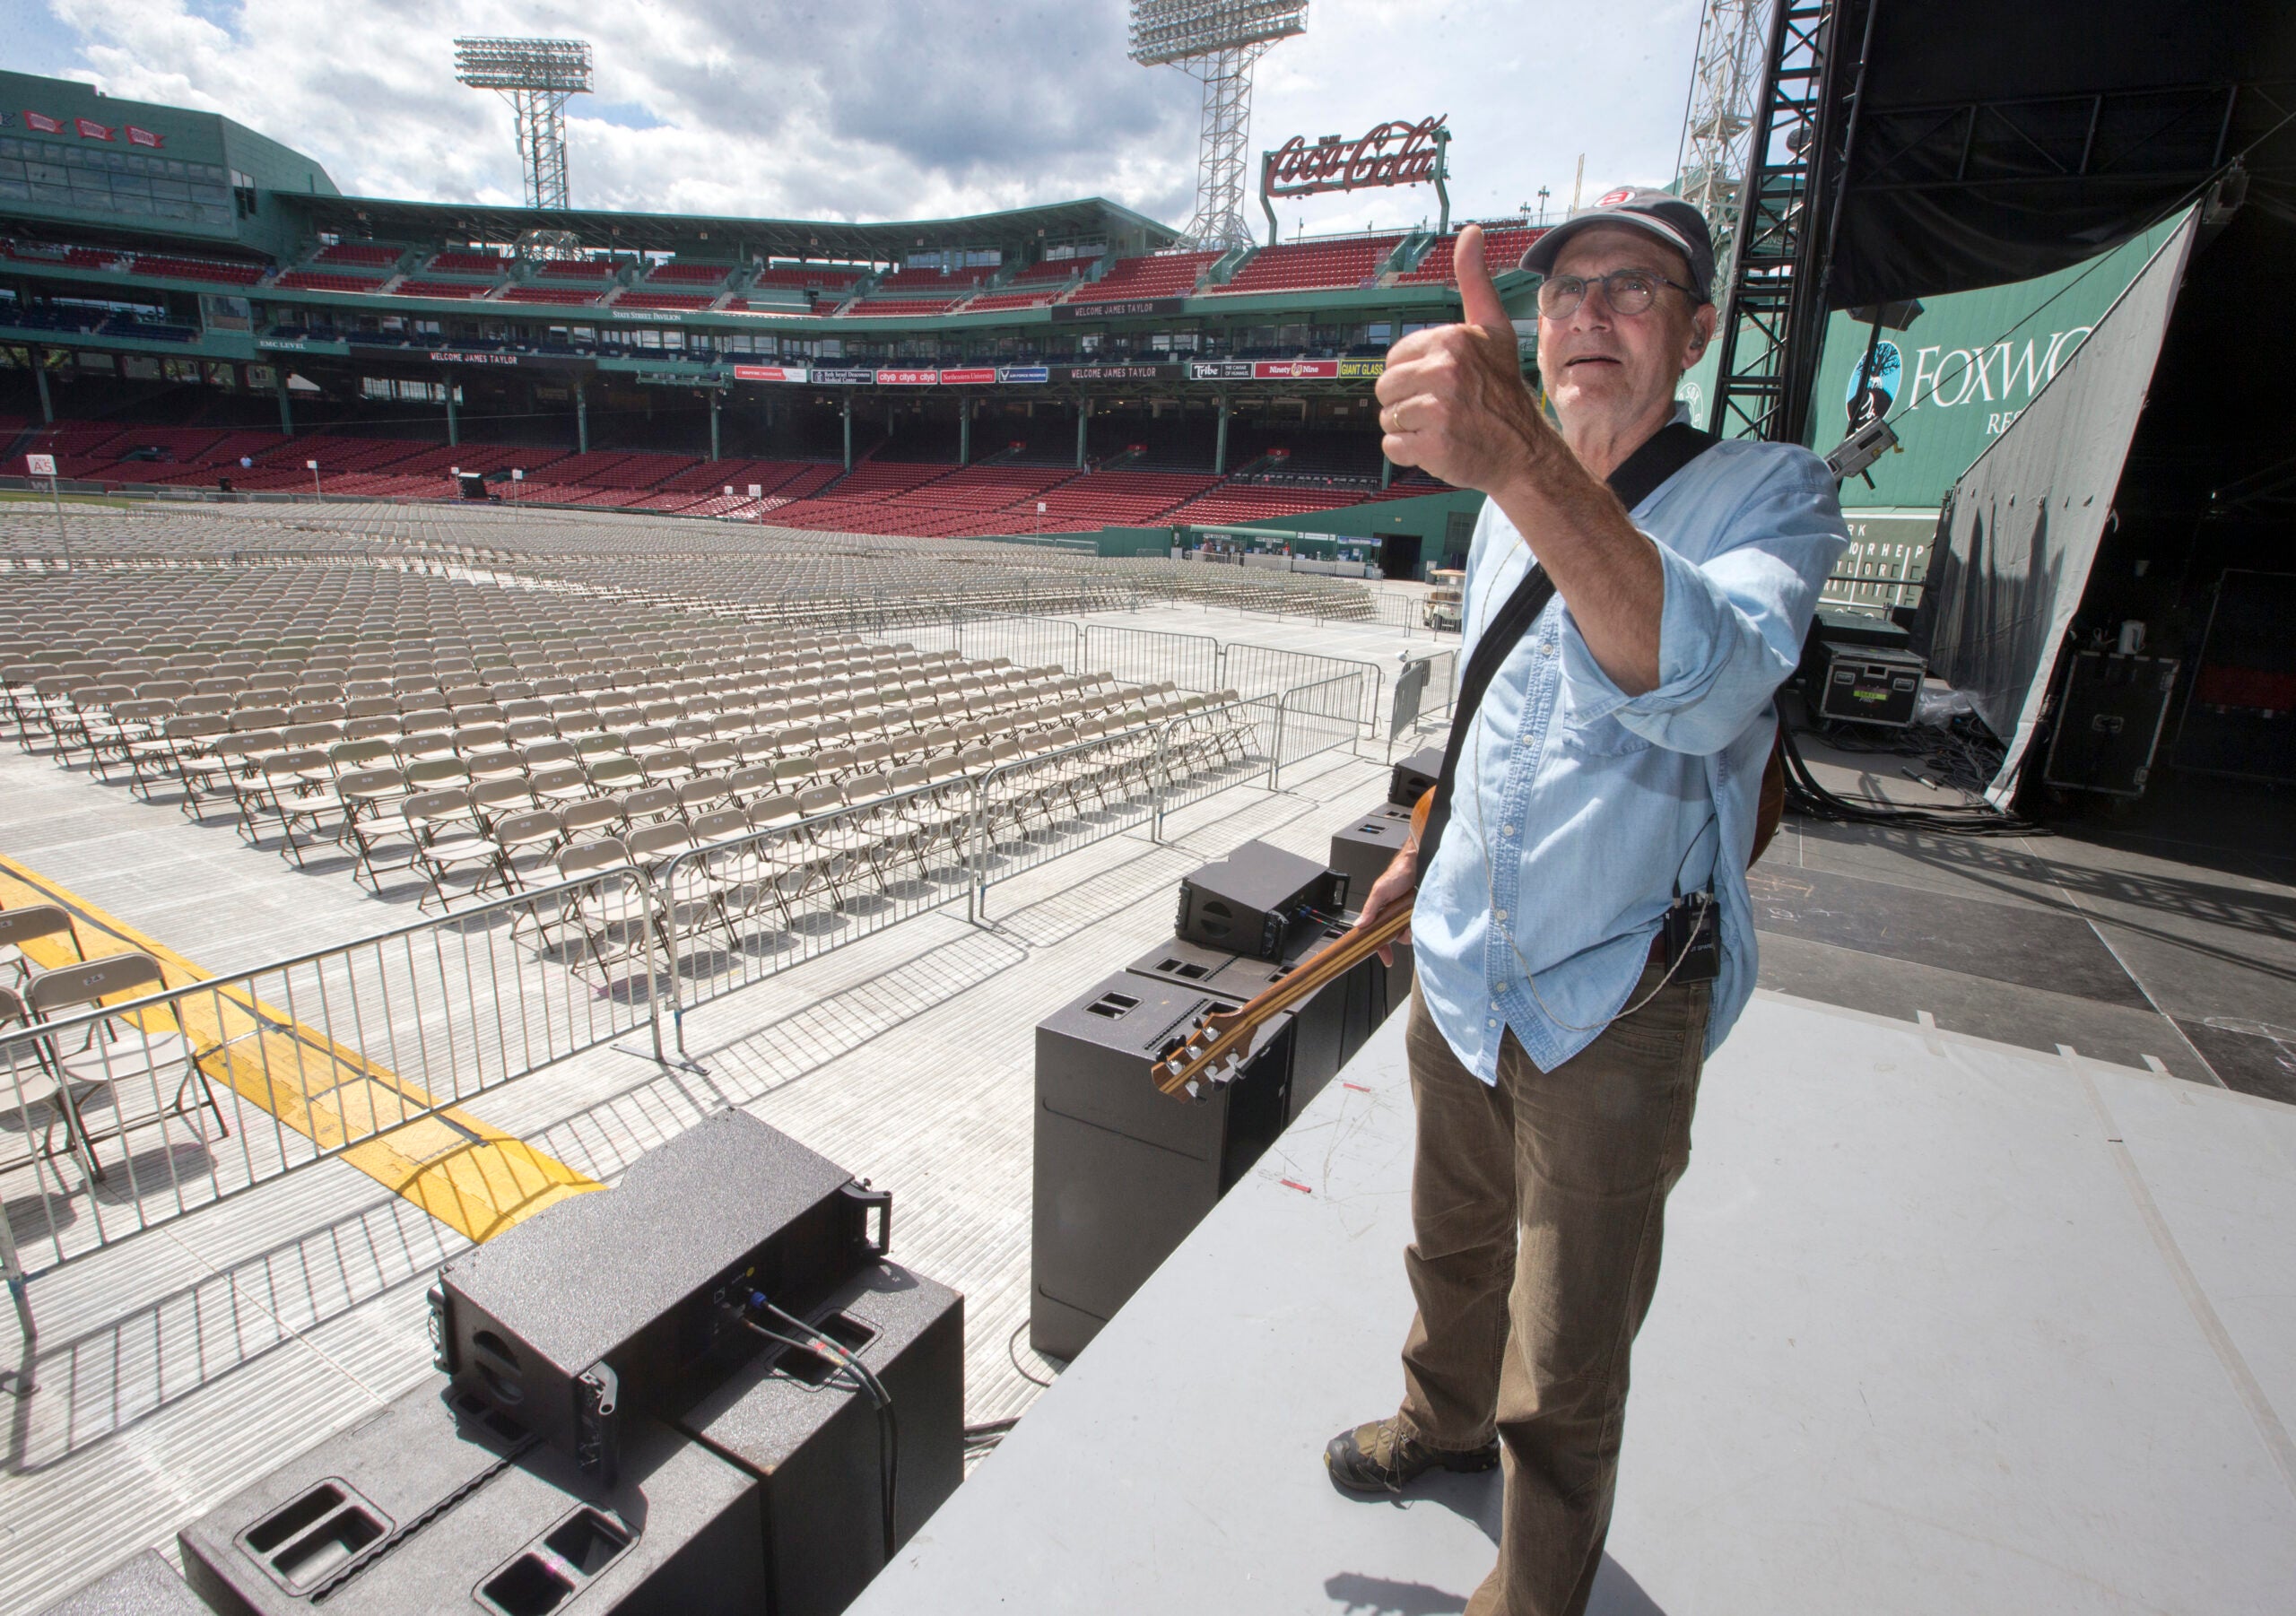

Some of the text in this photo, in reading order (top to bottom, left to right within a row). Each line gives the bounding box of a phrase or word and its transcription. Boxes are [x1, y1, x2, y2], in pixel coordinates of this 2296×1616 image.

[1265, 113, 1448, 196] Coca-Cola
[1074, 303, 1153, 316] WELCOME JAMES TAYLOR
[259, 340, 307, 350] EMC LEVEL
[430, 352, 518, 365] WELCOME JAMES TAYLOR
[1071, 367, 1156, 378] WELCOME JAMES TAYLOR
[1194, 364, 1219, 378] Tribe
[1269, 365, 1291, 375] Ninety
[1303, 365, 1319, 374] Nine
[1341, 363, 1384, 375] GIANT GLASS
[943, 372, 993, 381] Northeastern University
[34, 461, 52, 473] A5
